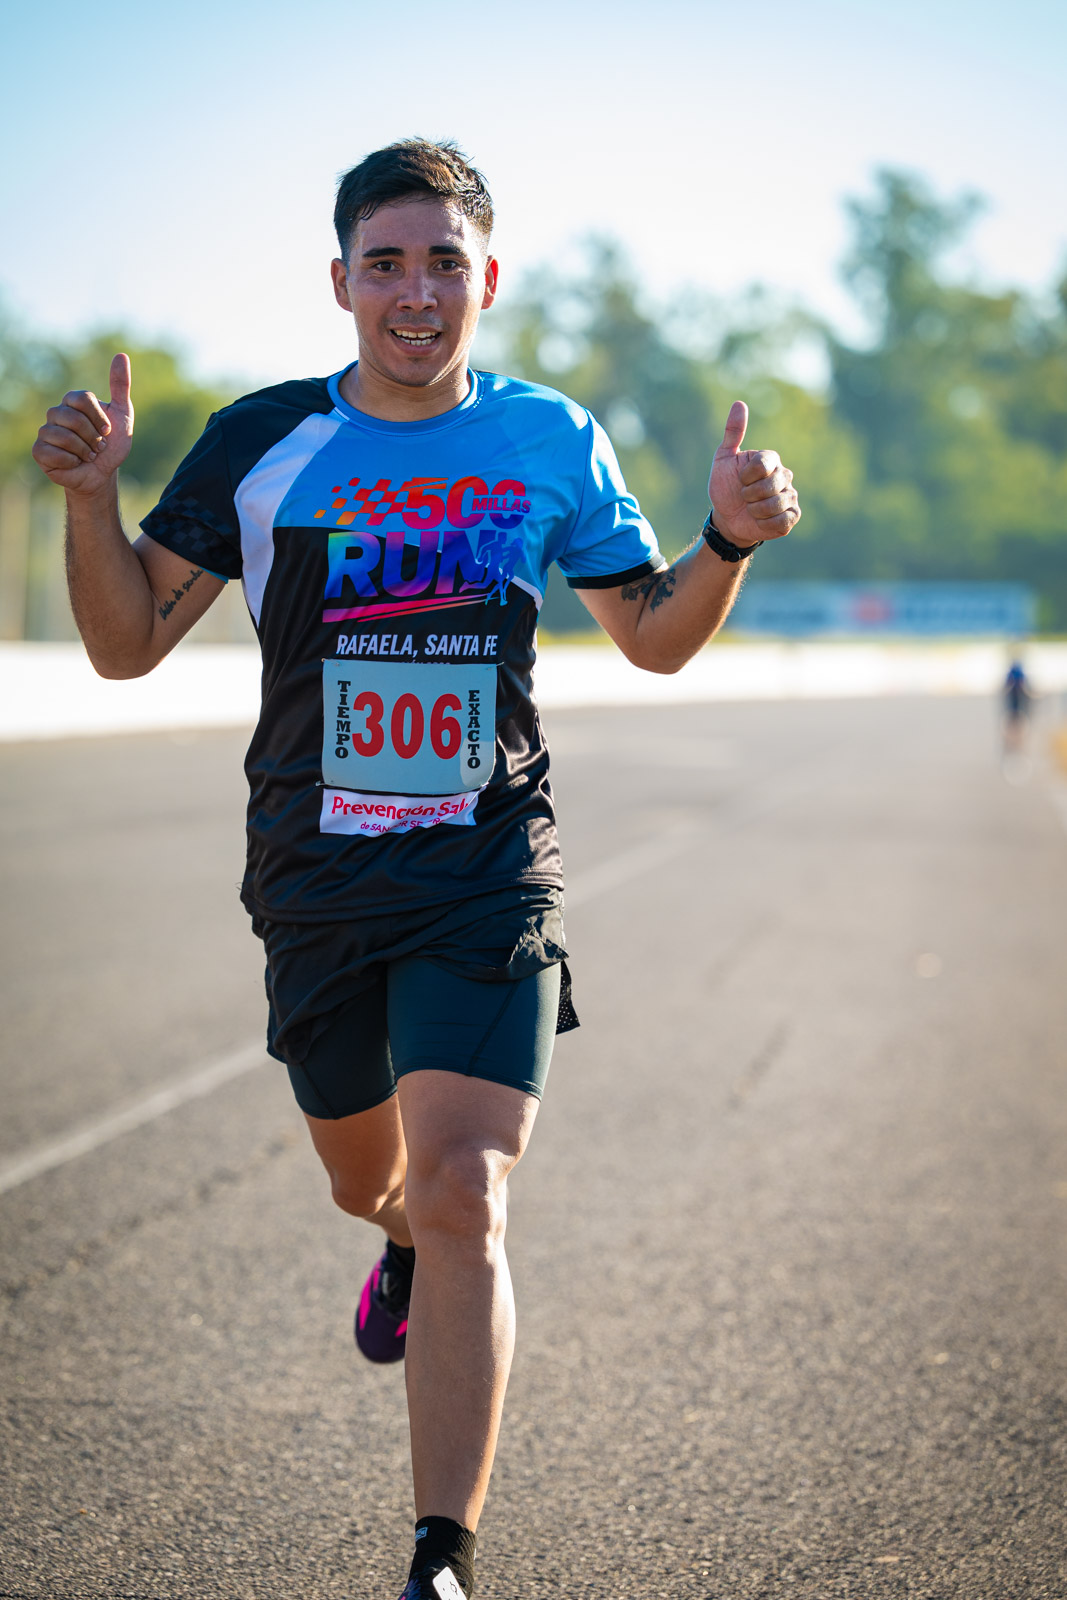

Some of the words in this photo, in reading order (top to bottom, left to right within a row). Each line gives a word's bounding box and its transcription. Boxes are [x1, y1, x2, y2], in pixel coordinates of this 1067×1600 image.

[401, 476, 526, 530] 500
[471, 497, 531, 514] MILLAS
[324, 529, 504, 600] RUN
[336, 634, 418, 658] RAFAELA,
[424, 635, 479, 656] SANTA
[483, 635, 498, 656] FE
[335, 680, 351, 759] TIEMPO
[352, 691, 462, 760] 306
[467, 690, 481, 769] EXACTO
[332, 796, 434, 820] Prevención
[360, 821, 370, 830] de
